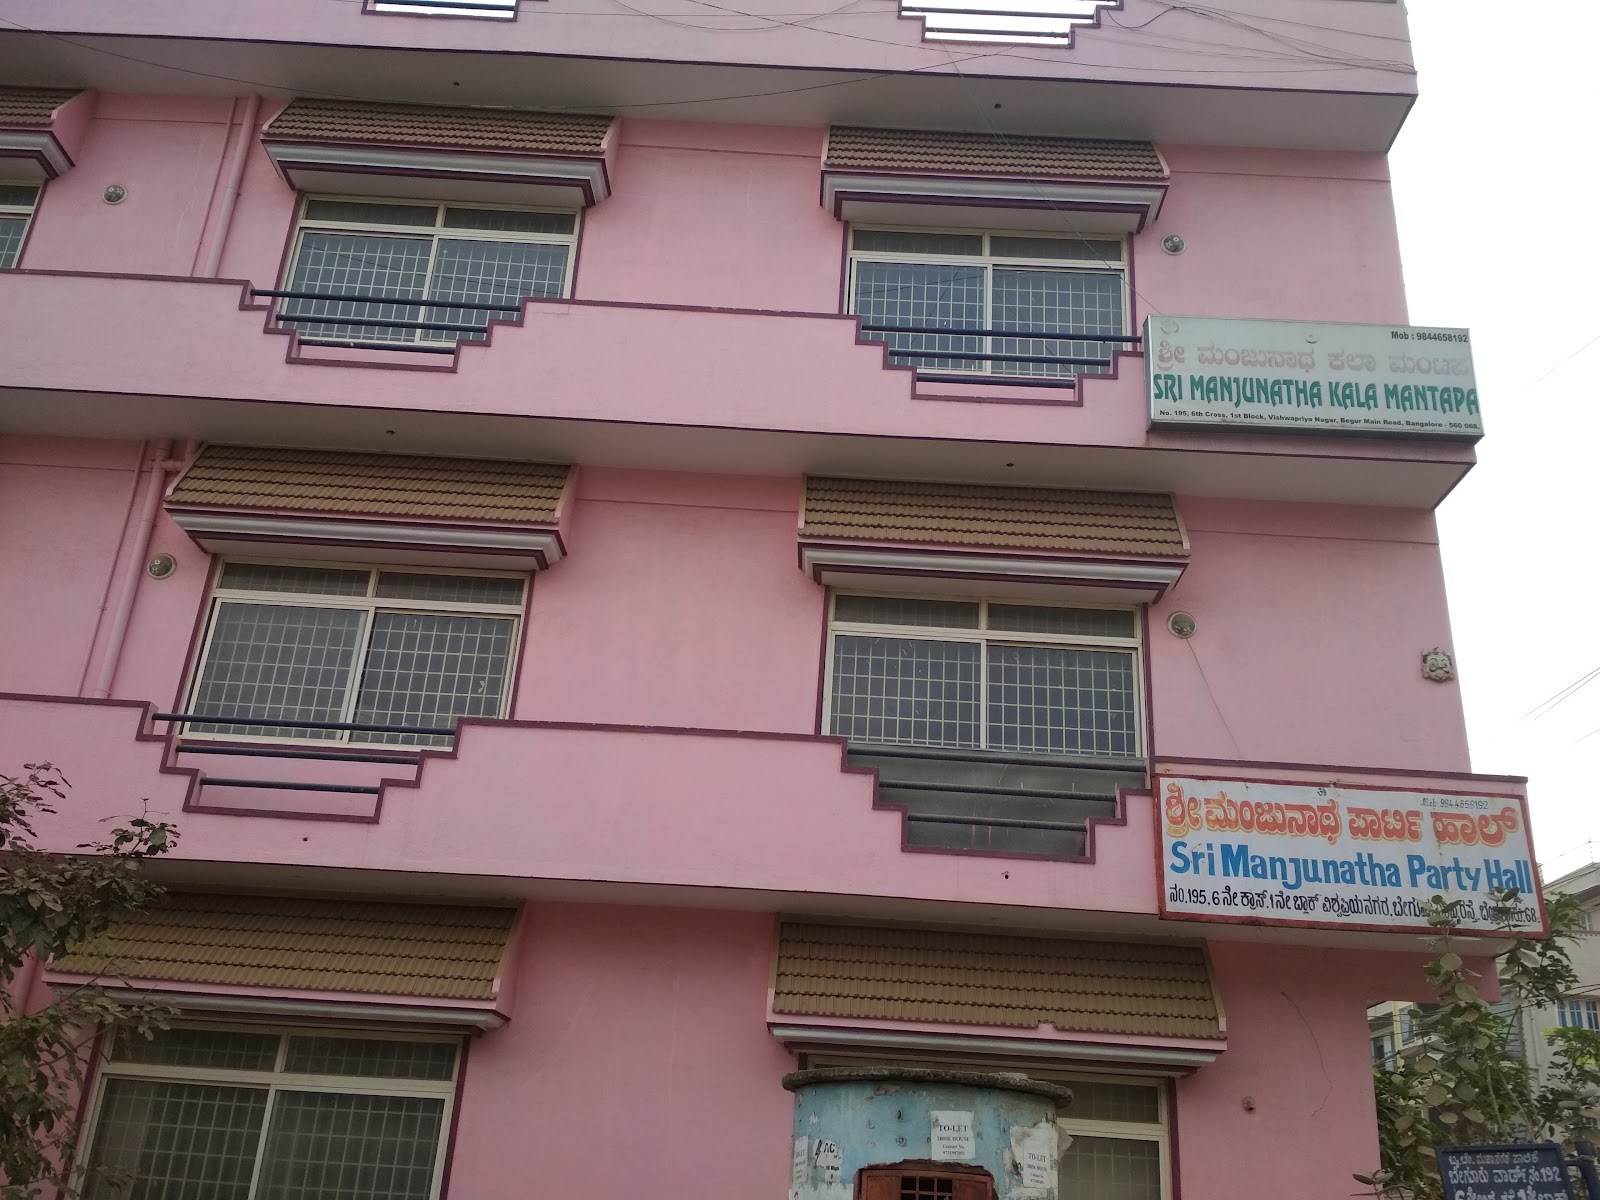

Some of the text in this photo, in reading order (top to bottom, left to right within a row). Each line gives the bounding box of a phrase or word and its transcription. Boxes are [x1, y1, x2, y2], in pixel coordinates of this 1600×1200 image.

[1391, 331, 1409, 340] Mob
[1416, 332, 1469, 343] 9844658192
[1153, 373, 1480, 415] SRI MANJUNATHA KALA MANTAPA
[1205, 411, 1228, 419] Cross,
[1268, 414, 1313, 422] Vishwapriya
[1315, 416, 1339, 424] Nagar,
[1383, 419, 1404, 427] Road,
[1165, 783, 1519, 847] ಶ್ರೀ ಮಂಜುನಾಥ ಪಾರ್ಟಿ ಹಾಲ್
[1170, 840, 1533, 894] Sri Manjunatha Party Hall
[939, 1124, 969, 1133] TO-LET
[1028, 1152, 1047, 1163] TO-LET
